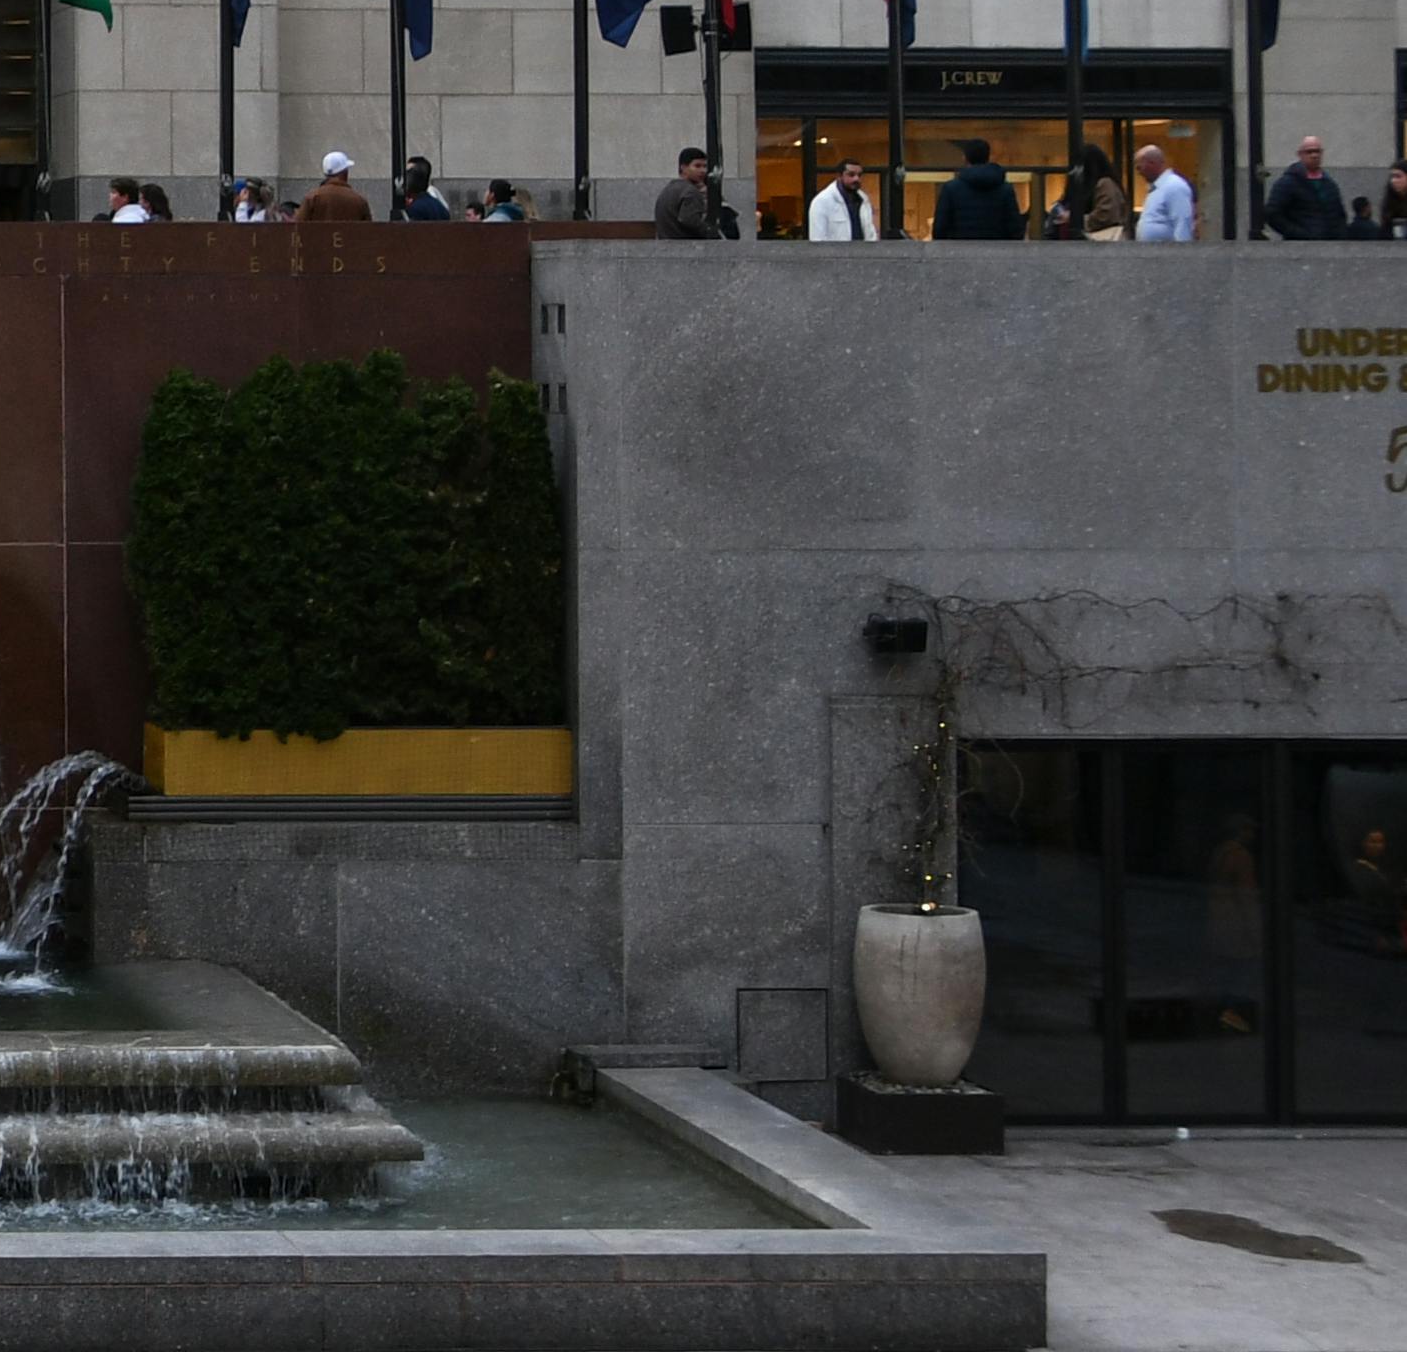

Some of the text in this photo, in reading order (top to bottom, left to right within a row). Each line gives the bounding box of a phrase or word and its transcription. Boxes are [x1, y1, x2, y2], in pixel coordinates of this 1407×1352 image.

[35, 232, 131, 249] THE
[206, 231, 344, 248] FIRE
[250, 256, 386, 274] ENDS
[1257, 363, 1389, 392] DINING
